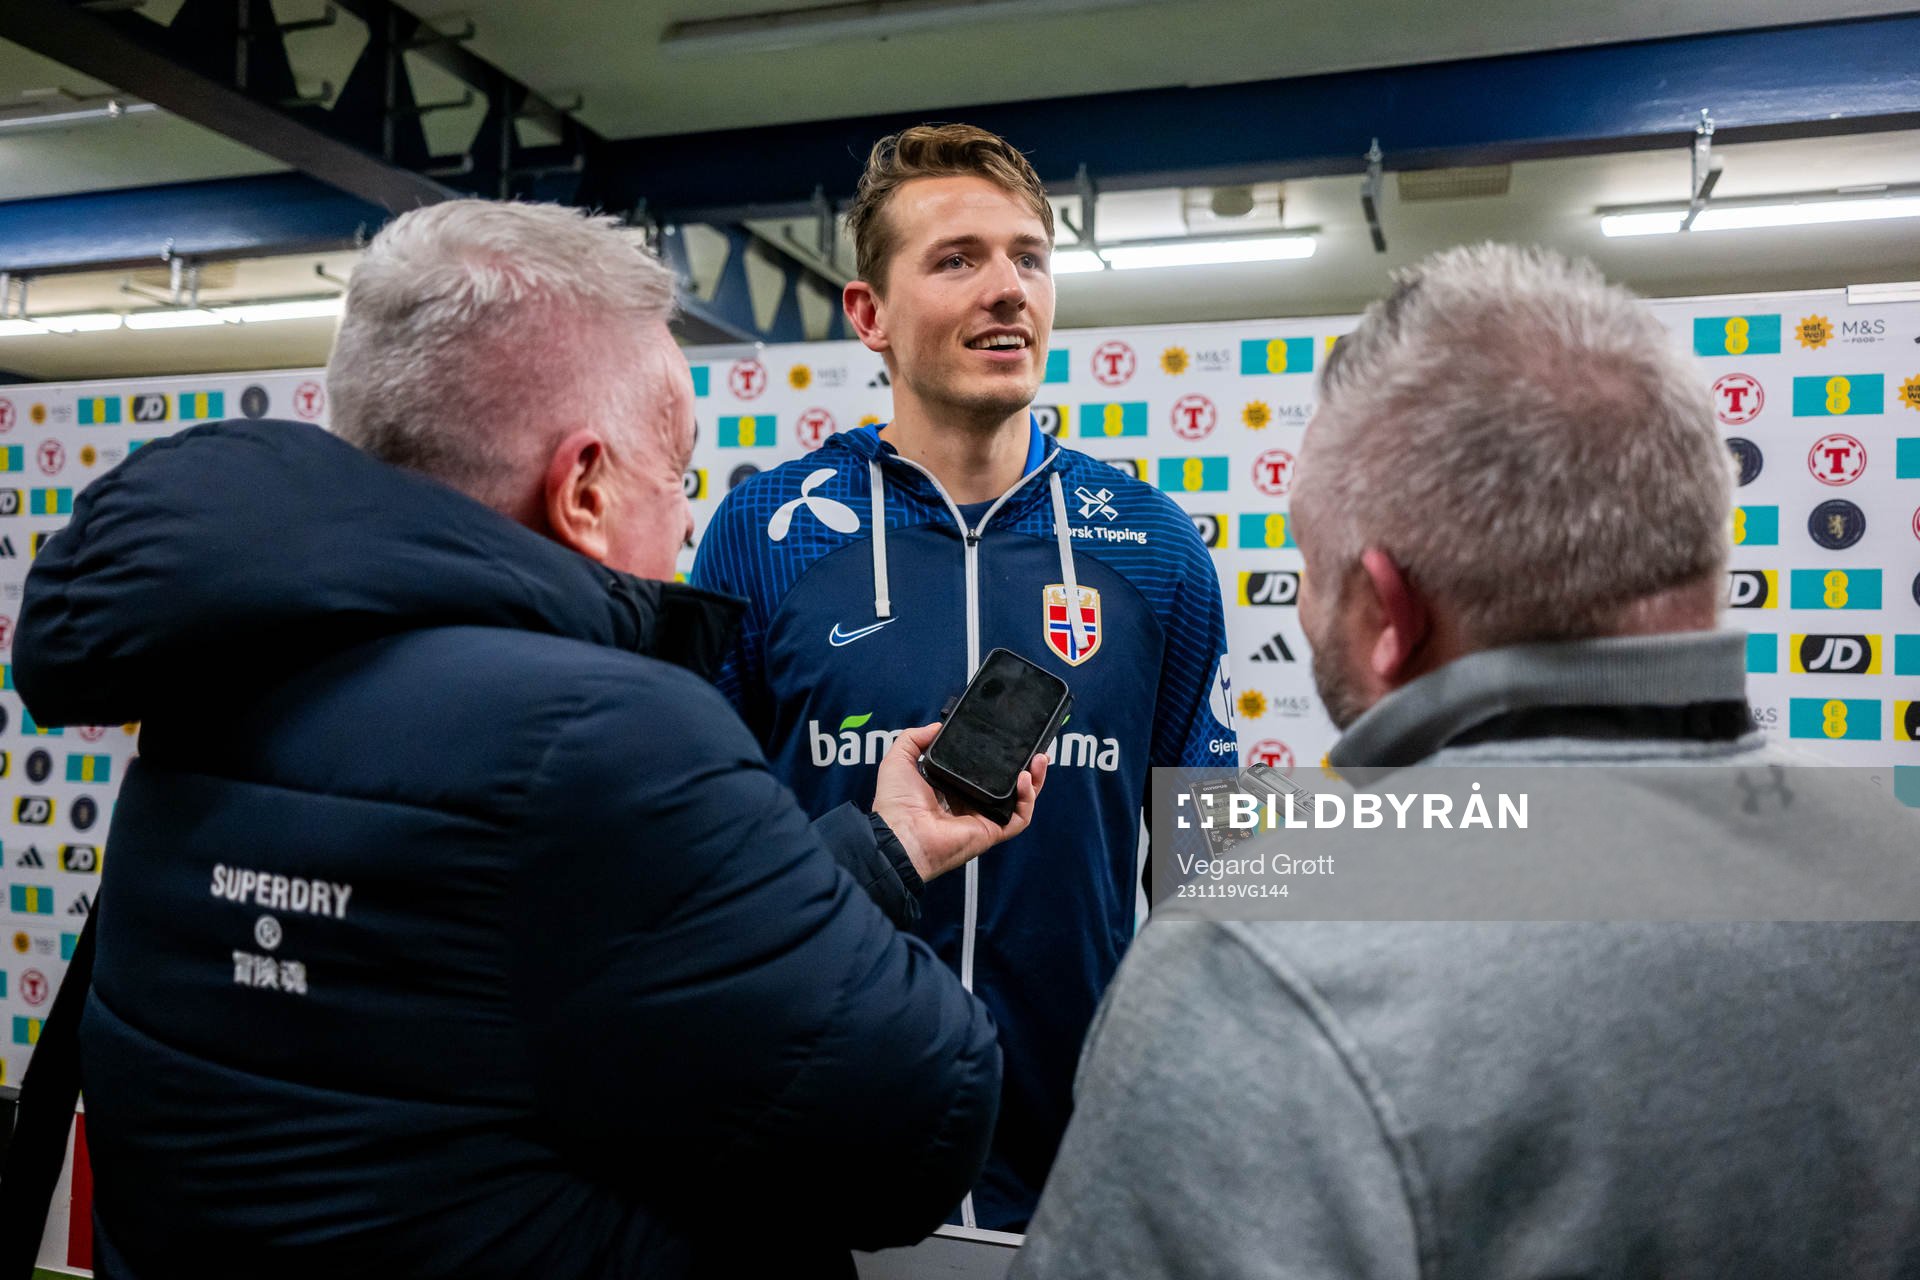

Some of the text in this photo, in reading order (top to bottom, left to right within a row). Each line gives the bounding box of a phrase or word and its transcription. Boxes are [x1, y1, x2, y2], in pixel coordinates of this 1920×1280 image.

[1842, 319, 1885, 336] M&S
[1724, 387, 1748, 412] T
[1824, 448, 1850, 474] T
[1094, 526, 1147, 544] Tipping
[1252, 573, 1298, 603] JD
[1809, 638, 1863, 670] JD
[809, 719, 907, 767] bam
[210, 863, 353, 919] SUPERDRY
